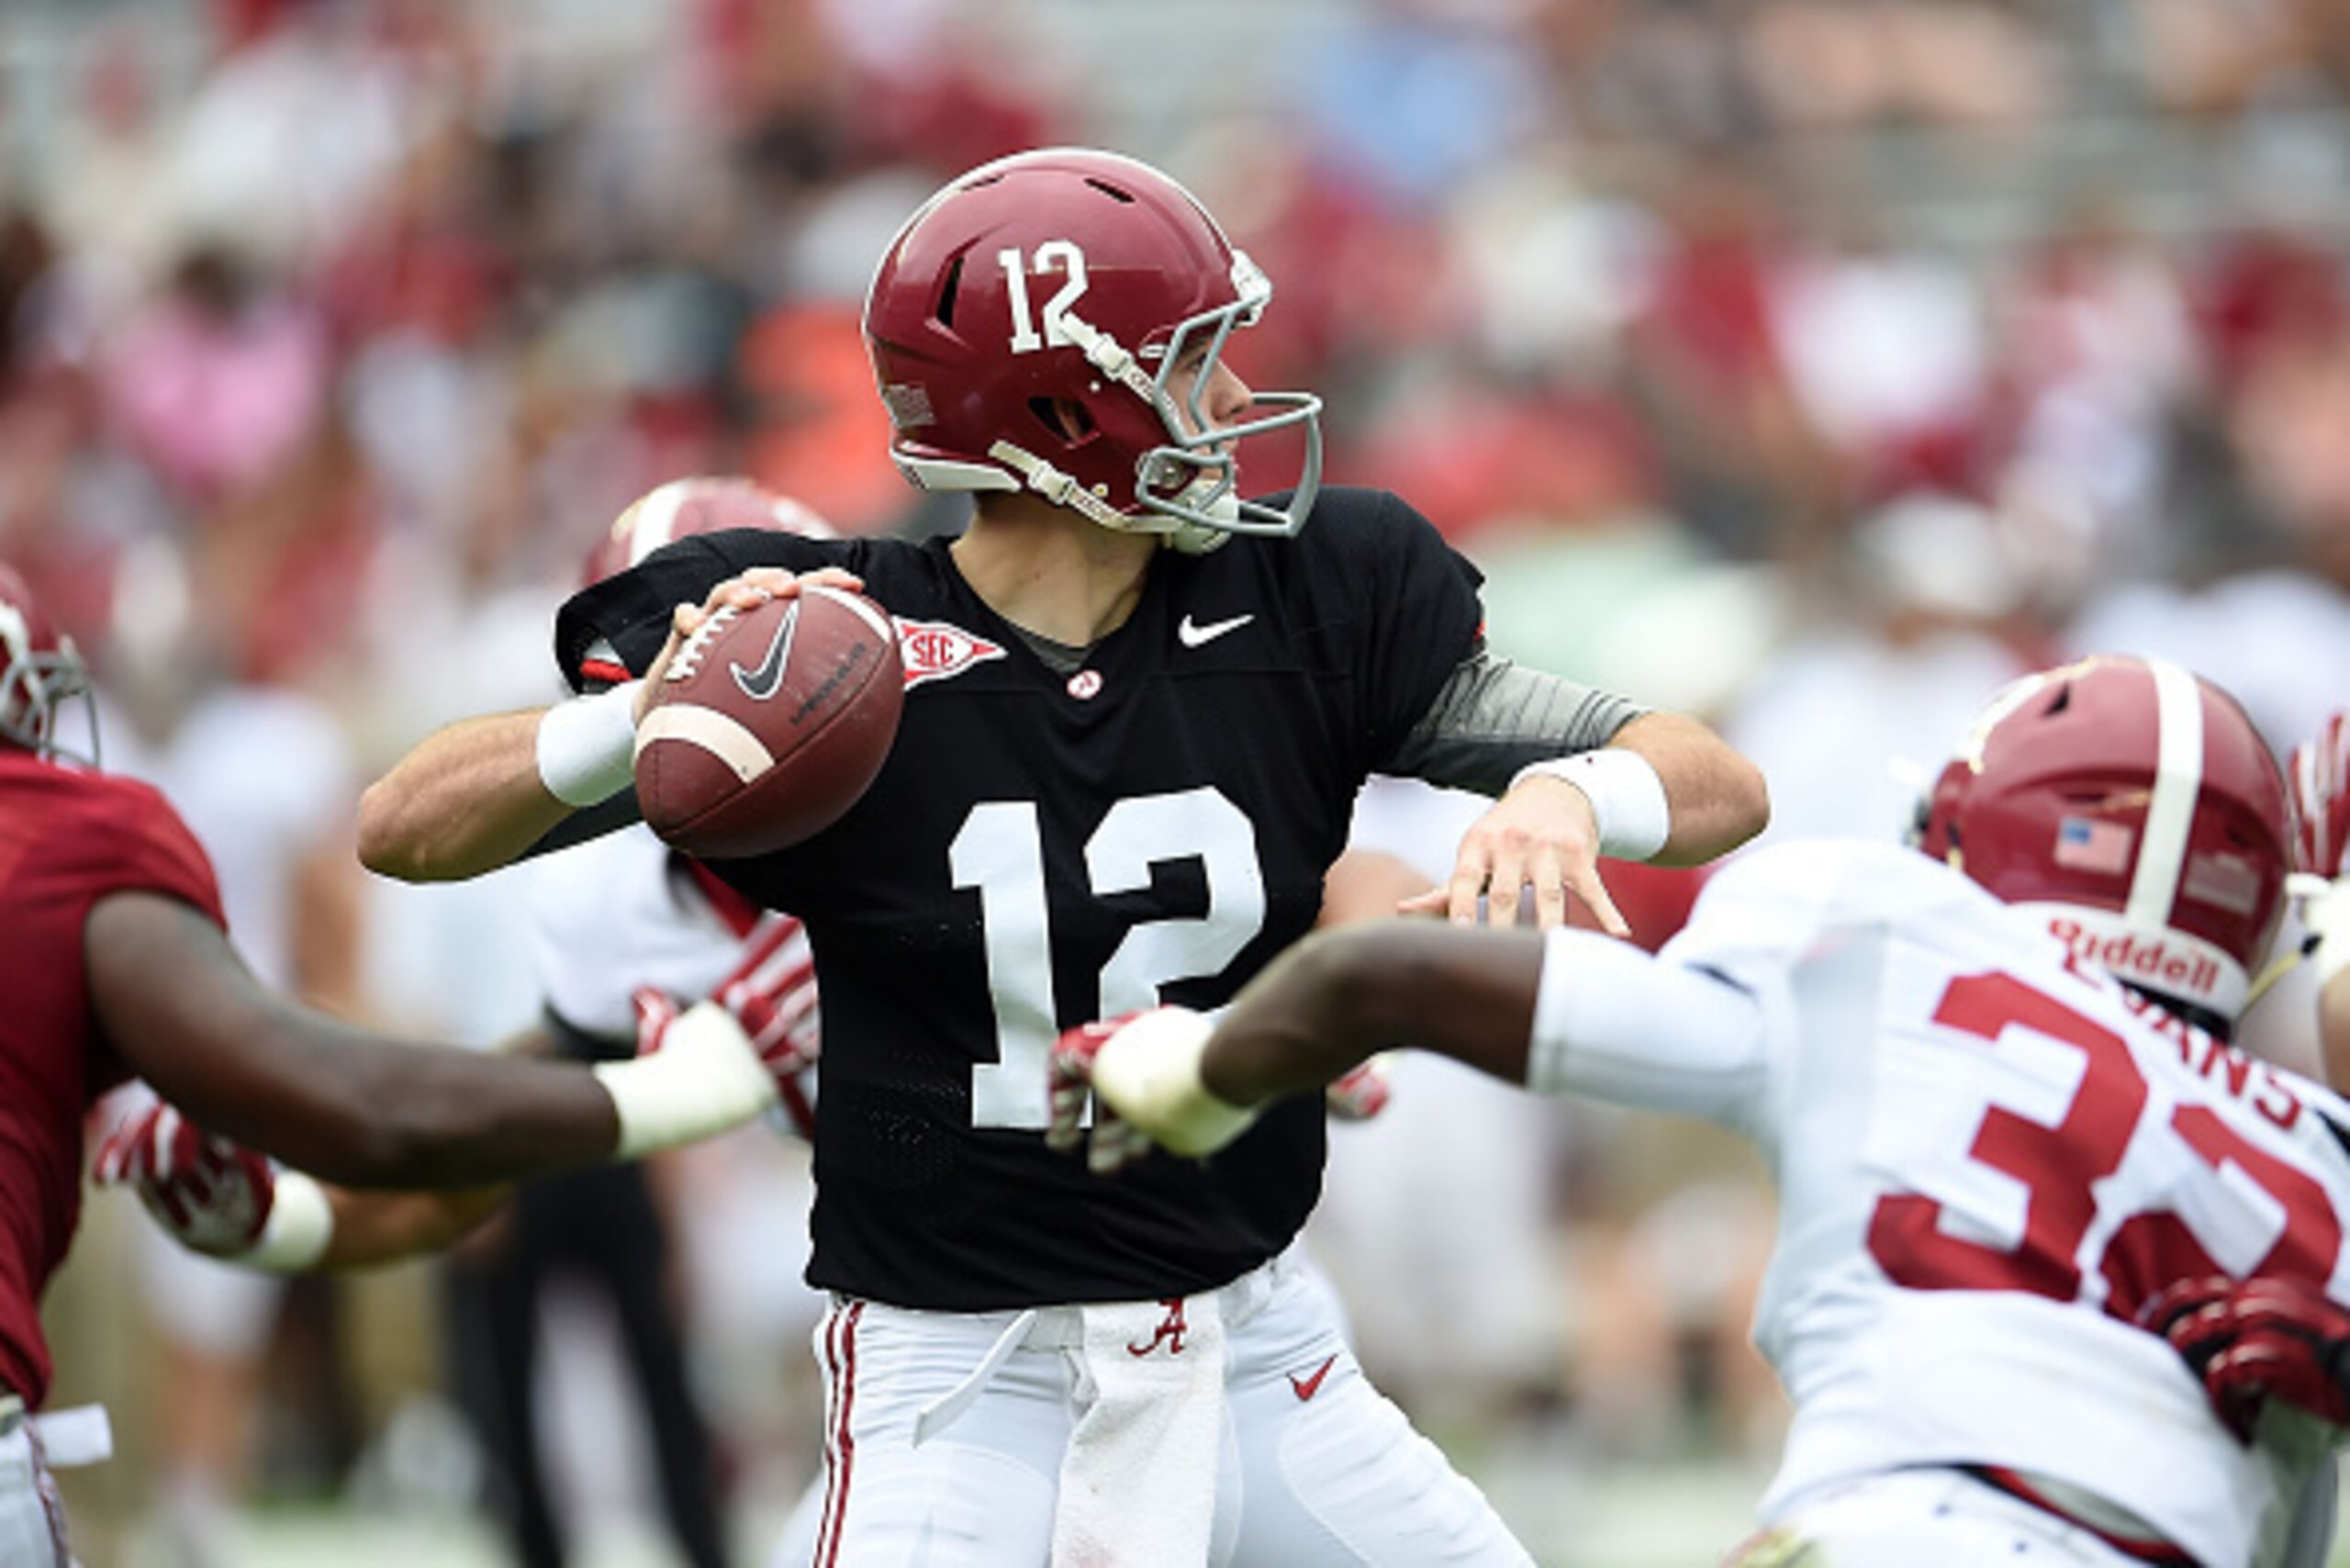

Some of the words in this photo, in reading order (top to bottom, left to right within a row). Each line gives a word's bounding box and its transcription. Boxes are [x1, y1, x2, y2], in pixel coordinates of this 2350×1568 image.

[997, 238, 1089, 354] 12
[911, 632, 955, 668] SEC
[948, 785, 1267, 1129] 12
[2049, 918, 2220, 995] Riddell
[1865, 969, 2344, 1333] 32
[1126, 1295, 1188, 1358] A
